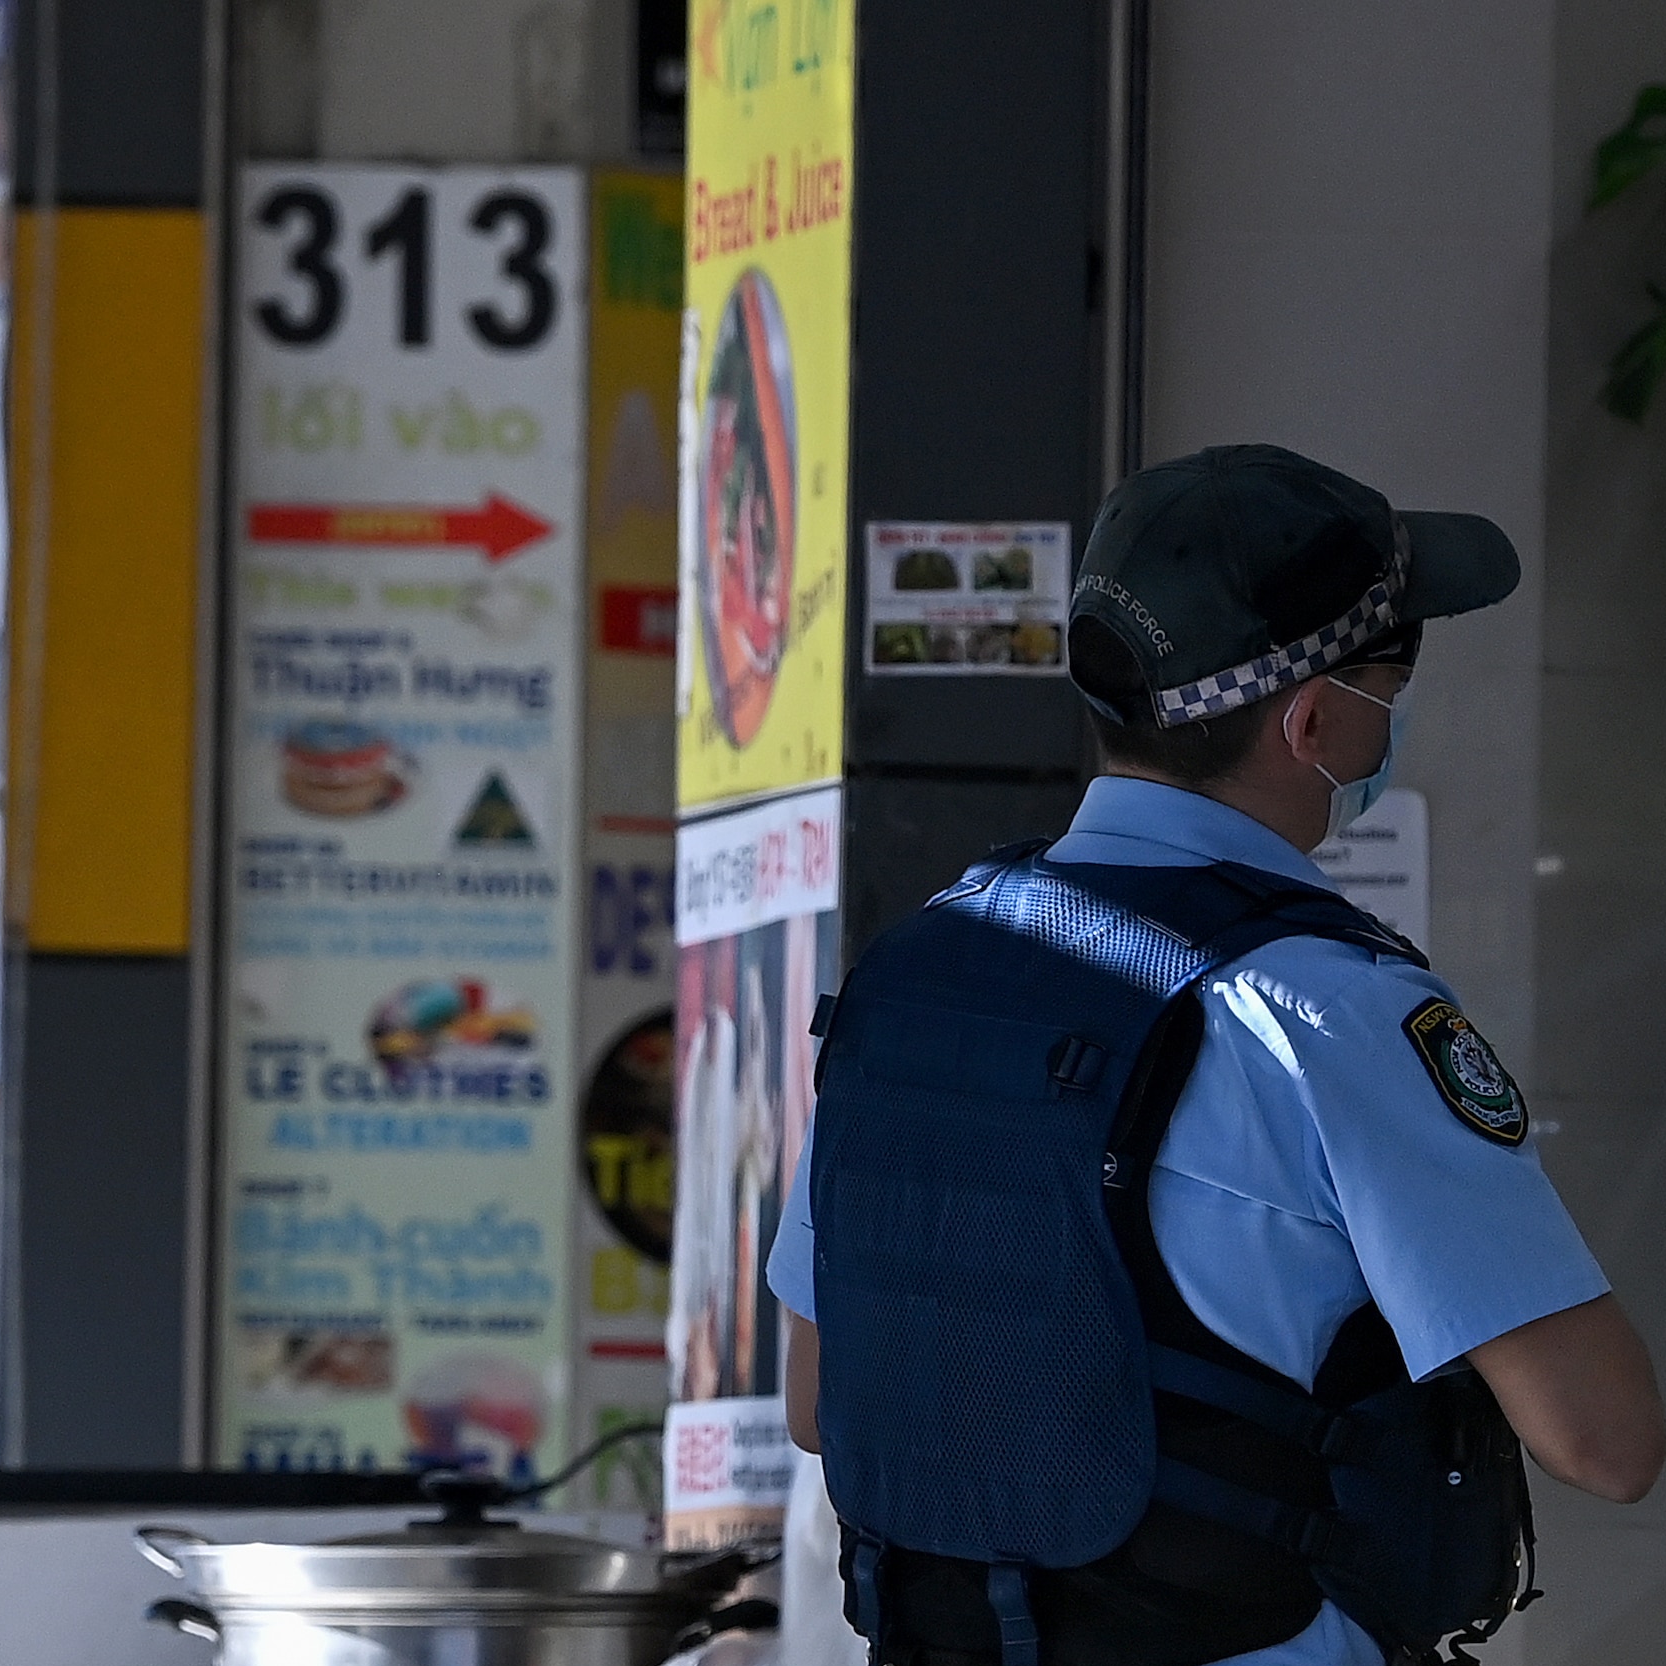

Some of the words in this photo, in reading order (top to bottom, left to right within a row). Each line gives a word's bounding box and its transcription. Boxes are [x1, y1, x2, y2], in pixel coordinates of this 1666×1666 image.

[693, 168, 759, 264] Bread
[253, 184, 563, 350] 313
[390, 386, 544, 458] vào
[1087, 574, 1131, 608] POLICE
[1128, 598, 1174, 657] FORCE
[242, 862, 560, 898] BETTERVITAMIN
[246, 1061, 303, 1102] LE
[321, 1061, 551, 1103] CLOTHES
[271, 1113, 532, 1150] ALTERATION
